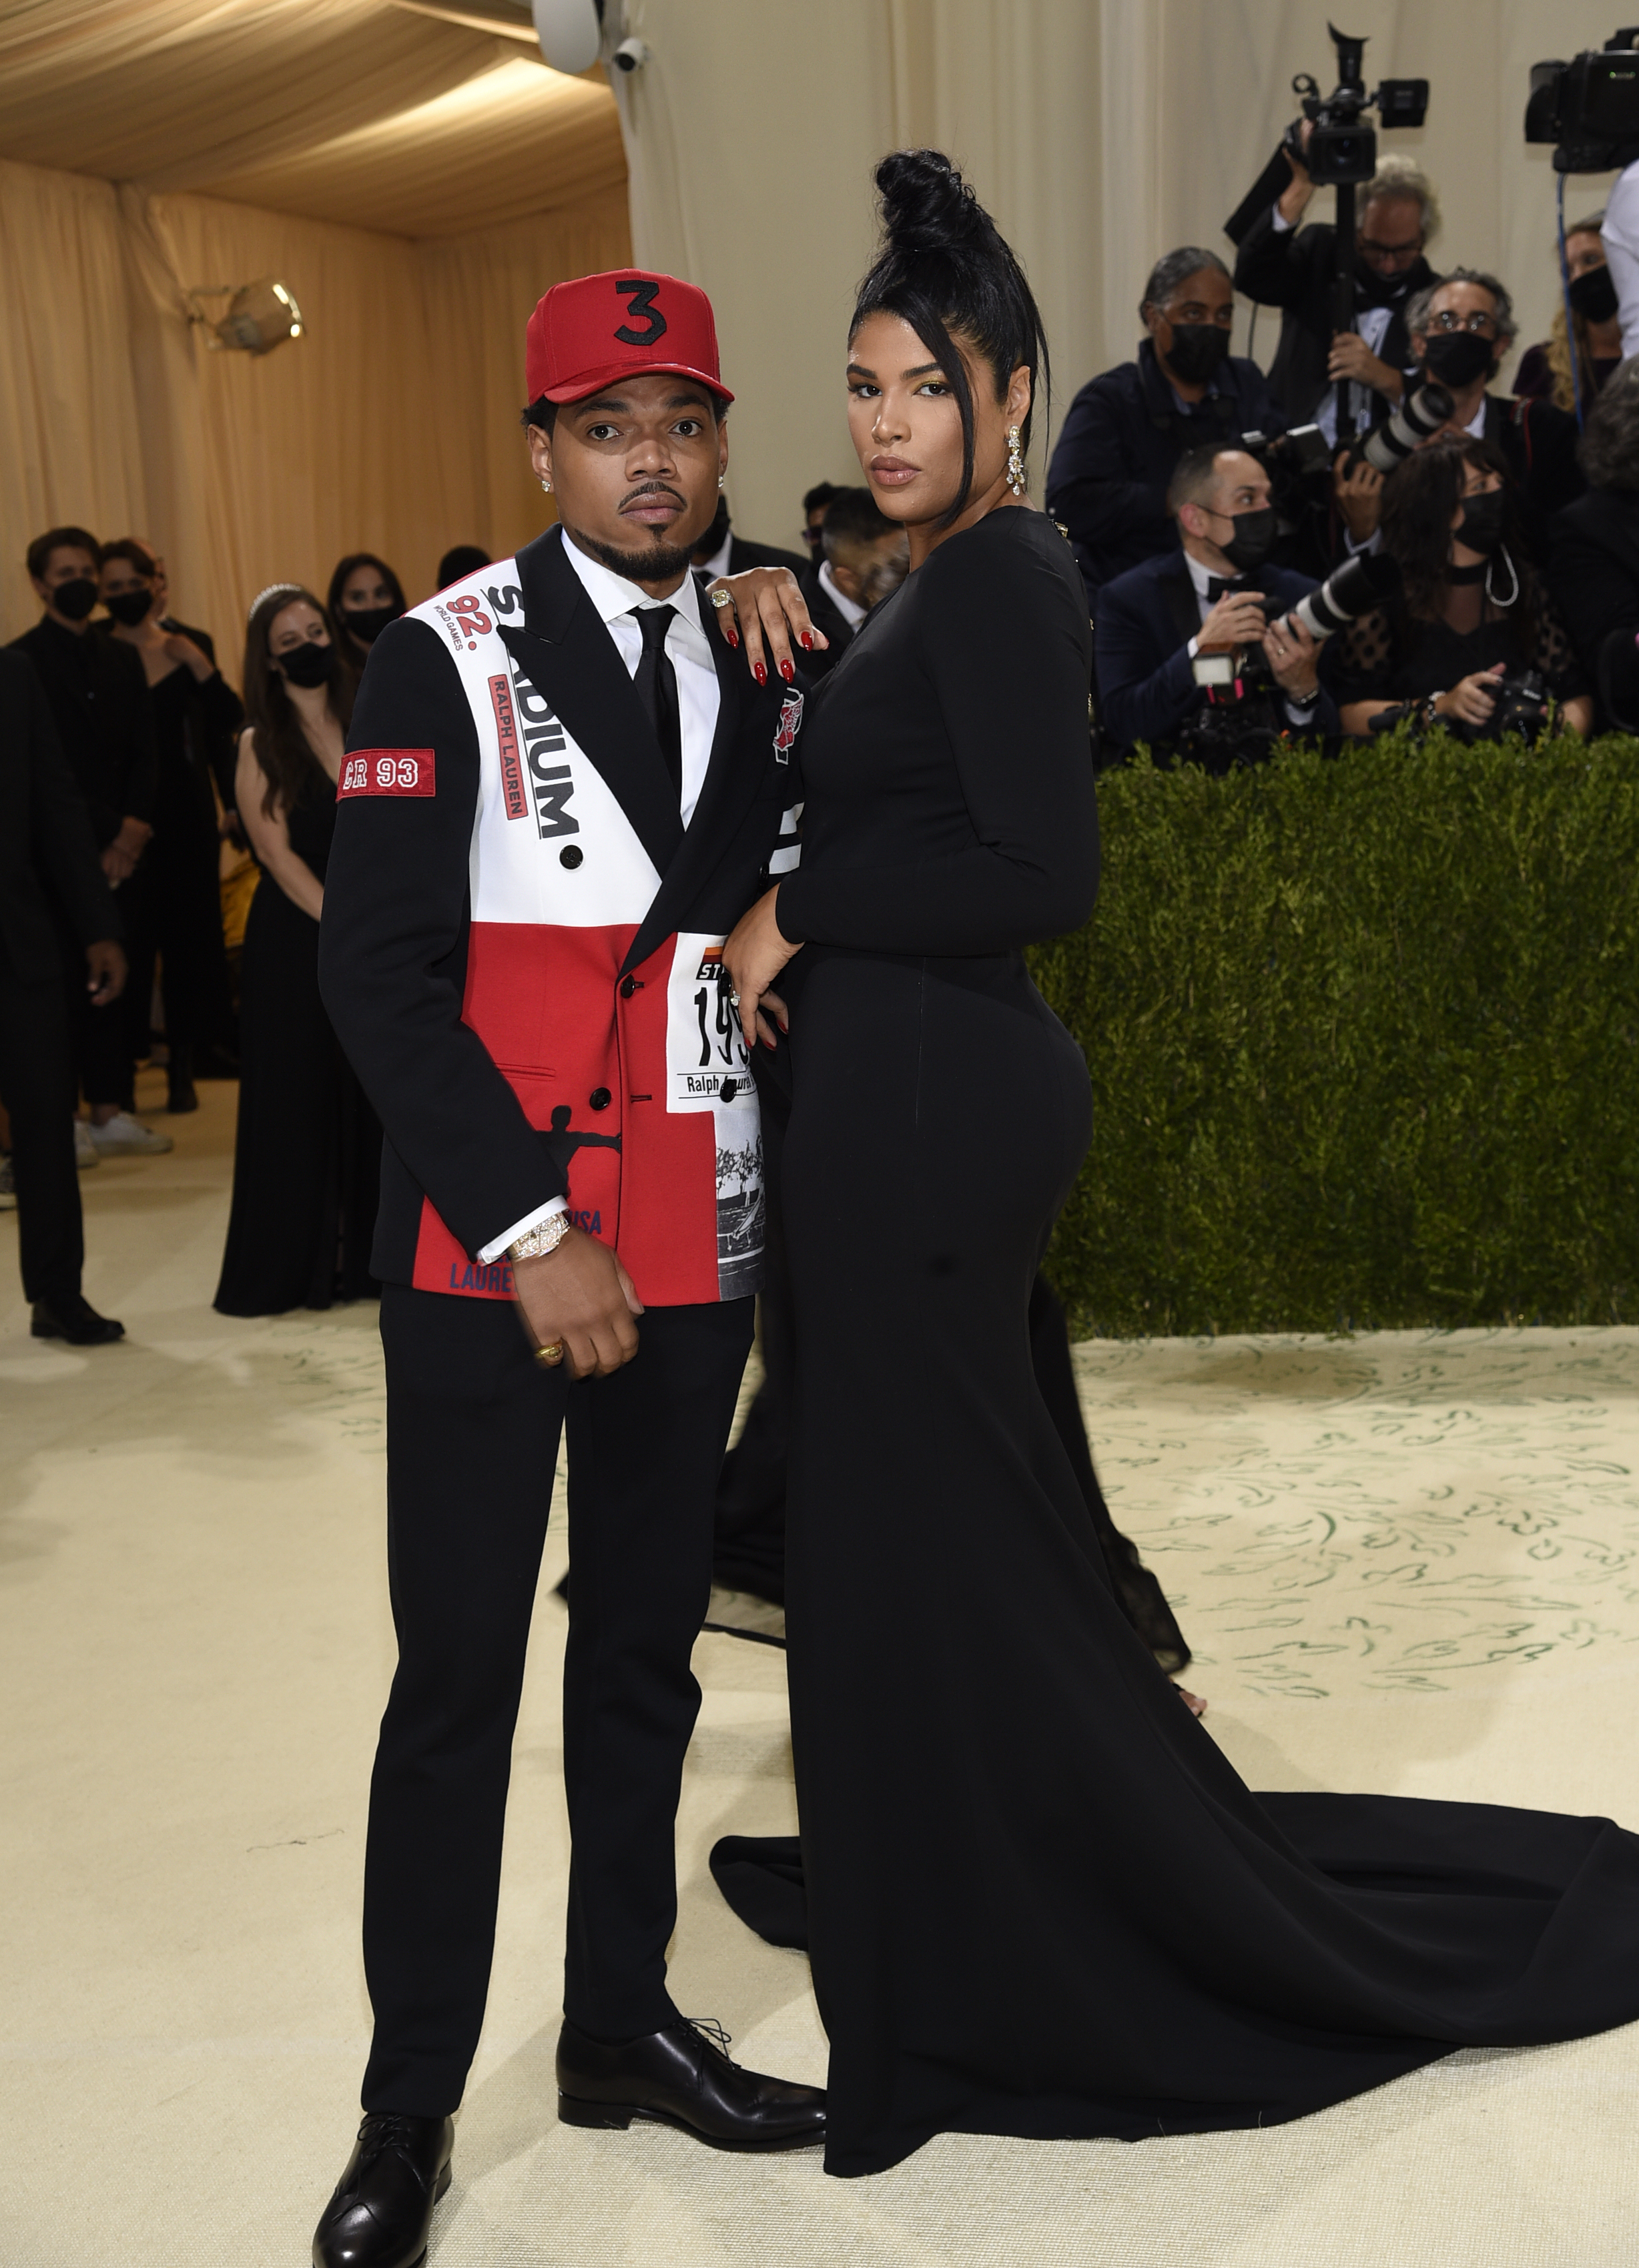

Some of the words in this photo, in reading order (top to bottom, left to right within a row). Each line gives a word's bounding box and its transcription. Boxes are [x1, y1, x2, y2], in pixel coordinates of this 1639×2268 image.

[613, 280, 667, 346] 3
[434, 605, 451, 622] WORLD
[446, 622, 464, 651] GAMES
[488, 585, 580, 839] SDIUM
[494, 681, 513, 738] RALPH
[342, 759, 367, 790] CR
[376, 758, 418, 787] 93
[502, 745, 523, 815] LAUREN
[687, 1074, 719, 1094] Ralph
[450, 1263, 517, 1292] LAURE
